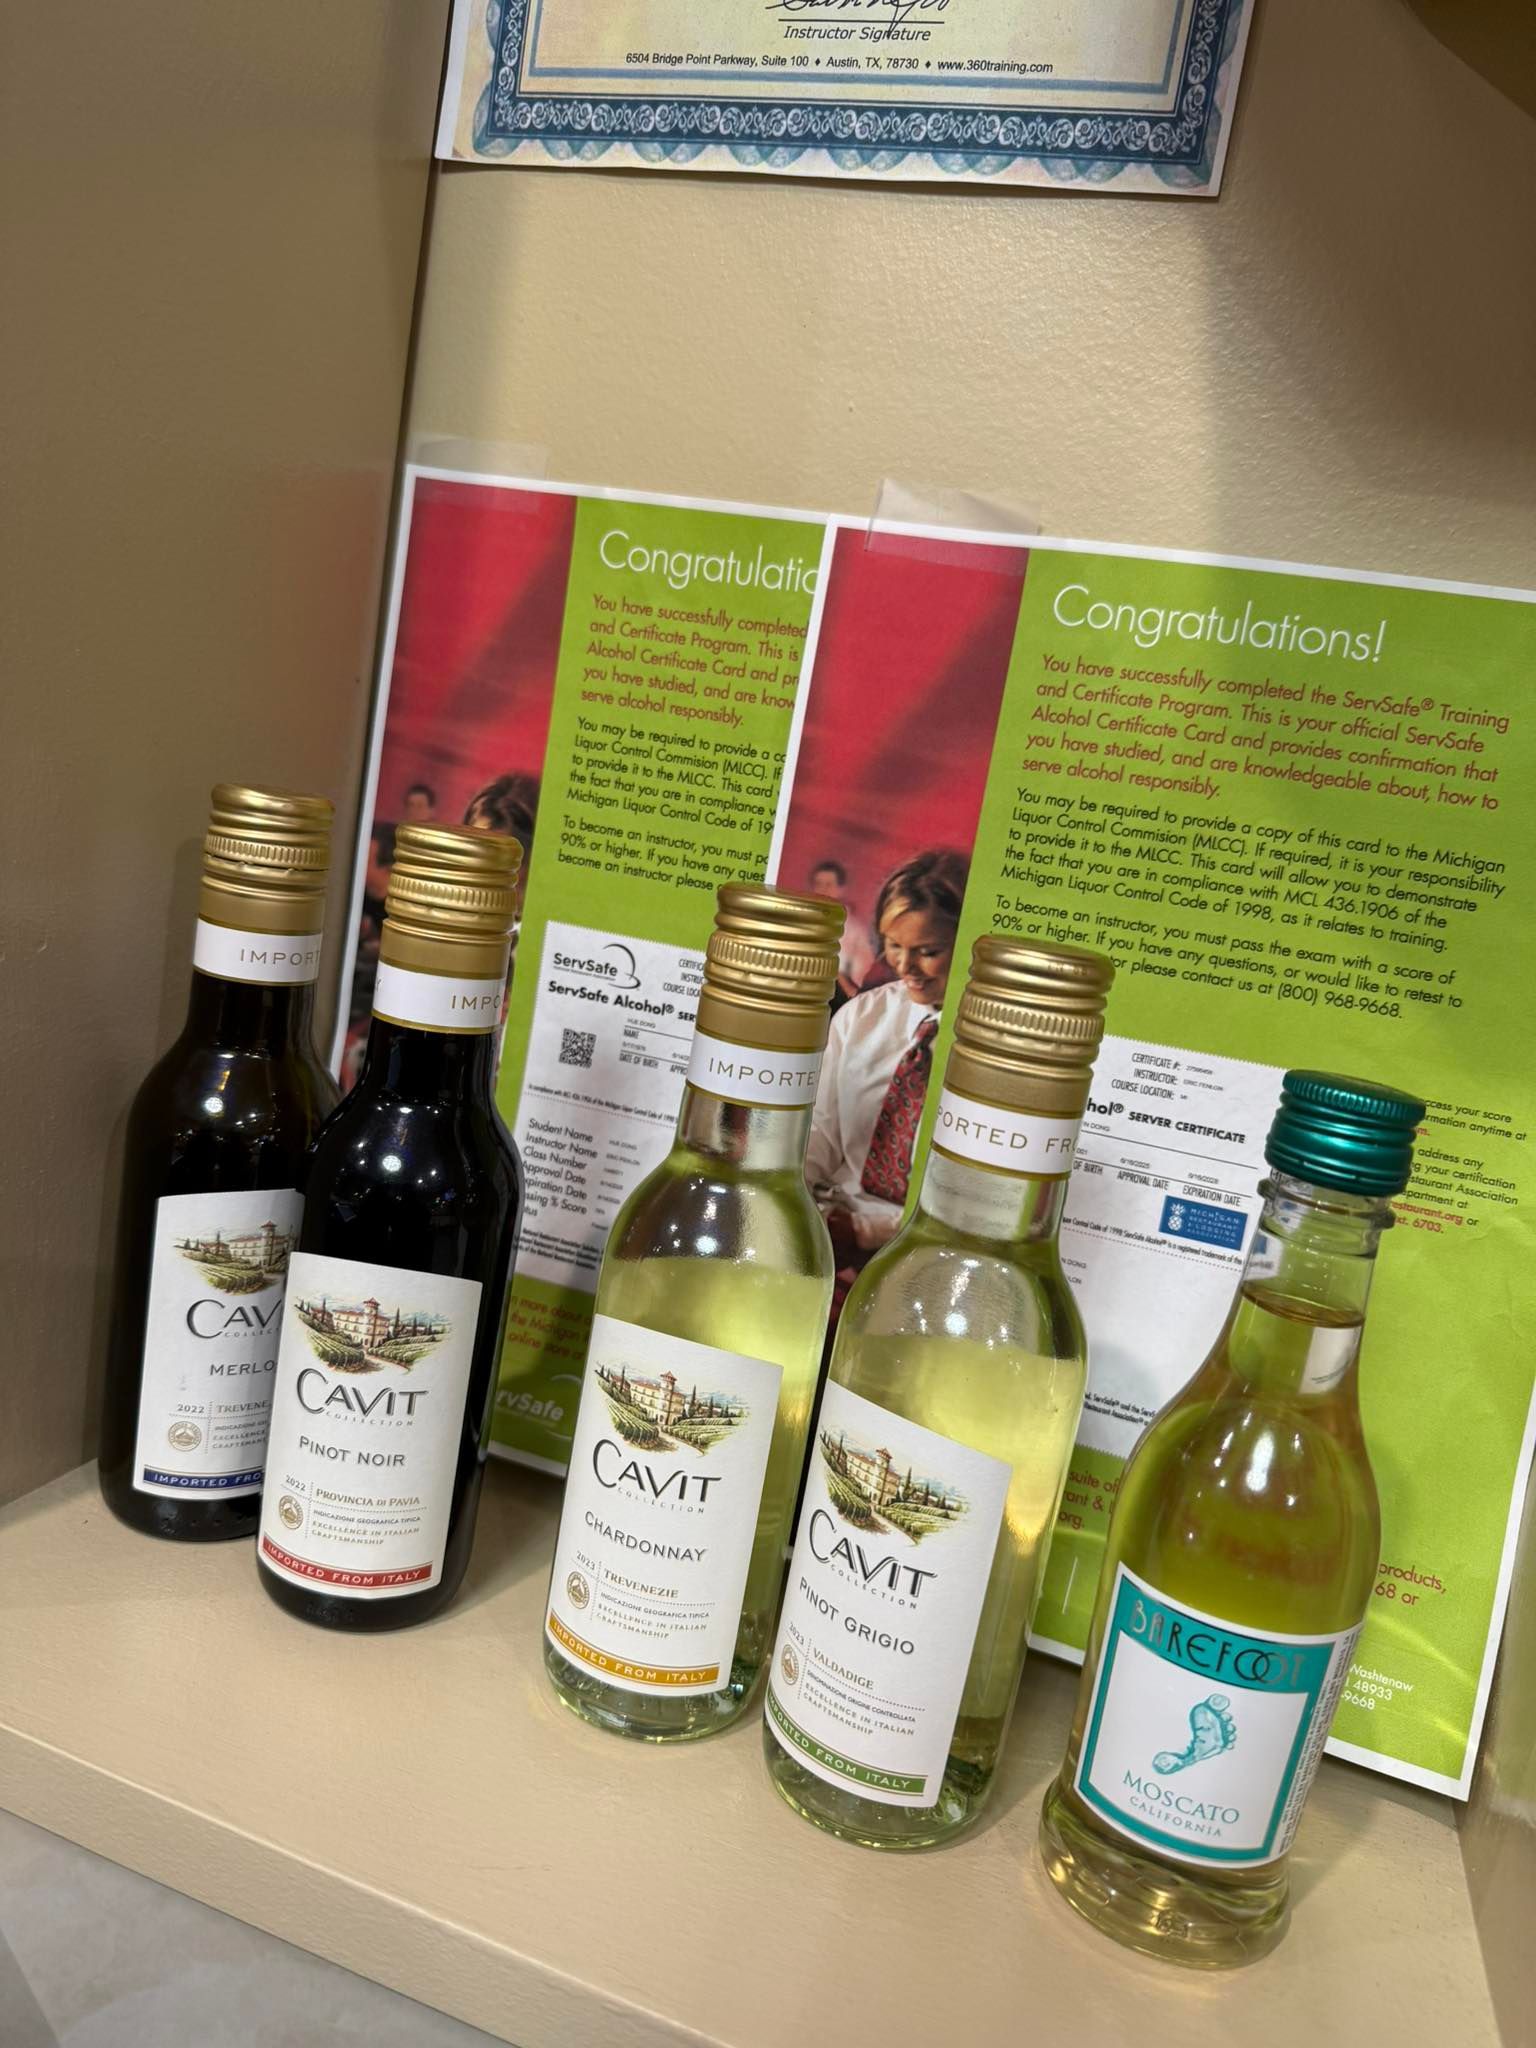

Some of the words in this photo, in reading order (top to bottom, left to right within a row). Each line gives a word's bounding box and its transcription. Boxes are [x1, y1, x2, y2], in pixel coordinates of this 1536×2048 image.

[783, 25, 857, 40] Instructor
[858, 23, 932, 43] Signature
[625, 52, 650, 64] 6504
[652, 52, 684, 67] Bridge
[685, 53, 711, 65] Point
[713, 53, 758, 68] Parkway,
[761, 54, 788, 67] Suite
[790, 55, 809, 67] 100
[825, 56, 861, 69] Austin,
[865, 56, 883, 70] TX,
[886, 57, 920, 70] 78730
[937, 59, 1054, 75] www.360training.com
[592, 593, 617, 612] You
[621, 597, 654, 617] have
[655, 607, 734, 631] successfully
[737, 619, 808, 639] completed
[1052, 586, 1386, 662] Congratulations!
[580, 689, 617, 705] serve
[617, 692, 666, 713] alcohol
[669, 704, 744, 729] responsibly.
[1036, 680, 1069, 699] and
[1071, 683, 1154, 709] Certificate
[1156, 693, 1233, 720] Program.
[1242, 704, 1273, 725] This
[1278, 714, 1291, 727] is
[1295, 716, 1338, 734] your
[1339, 719, 1400, 741] official
[1405, 726, 1485, 753] ServSafe
[1042, 653, 1071, 674] You
[1075, 656, 1115, 678] have
[1119, 667, 1213, 695] successfully
[1216, 680, 1306, 702] completed
[1310, 686, 1337, 706] the
[1440, 703, 1510, 734] Training
[1030, 704, 1093, 728] Alcohol
[1096, 712, 1179, 739] Certificate
[1183, 723, 1227, 745] Card
[1230, 733, 1266, 750] and
[1268, 740, 1343, 761] provides
[1347, 749, 1457, 777] confirmation
[1463, 761, 1499, 783] that
[1022, 759, 1063, 776] serve
[1066, 760, 1125, 784] alcohol
[1128, 773, 1221, 801] responsibly.
[1025, 734, 1056, 750] you
[1060, 732, 1099, 754] have
[1103, 741, 1165, 766] studied,
[1171, 751, 1206, 768] and
[1209, 758, 1239, 773] are
[1241, 757, 1372, 792] knowledgeable
[1375, 778, 1430, 804] about,
[1435, 785, 1478, 807] how
[1481, 793, 1499, 811] to
[1000, 863, 1064, 889] Michigan
[1067, 874, 1110, 895] Liquor
[1113, 882, 1165, 903] Control
[1168, 890, 1209, 910] Code
[1212, 898, 1230, 913] of
[1235, 901, 1275, 924] 1998,
[1280, 913, 1299, 925] as
[1303, 914, 1313, 927] it
[1315, 915, 1365, 937] relates
[1369, 925, 1385, 939] to
[1388, 928, 1448, 954] training.
[1129, 957, 1179, 978] please
[1181, 970, 1235, 988] contact
[1237, 980, 1253, 993] us
[1257, 983, 1274, 997] at
[1275, 982, 1319, 1007] (800)
[1324, 990, 1403, 1019] 968-9668.
[1046, 1136, 1079, 1154] FR
[177, 1404, 205, 1413] 2022
[296, 1368, 431, 1418] CAVIT
[299, 1435, 351, 1463] PINOT
[357, 1449, 406, 1467] NOIR
[592, 1438, 722, 1503] CAVIT
[153, 1474, 228, 1487] IMPORTED
[285, 1475, 306, 1492] 2022
[316, 1489, 374, 1506] PROVINCIA
[377, 1499, 387, 1507] DI
[390, 1496, 420, 1506] PAVIA
[584, 1510, 708, 1563] CHARDONNAY
[809, 1508, 937, 1599] CAVIT
[267, 1544, 326, 1579] IMPORTED
[332, 1572, 373, 1585] FROM
[381, 1570, 422, 1584] ITALY
[575, 1551, 597, 1572] 2023
[603, 1568, 679, 1599] TREVENEZIE
[830, 1562, 918, 1609] COLLECTION
[799, 1577, 839, 1622] PINOT
[844, 1616, 915, 1655] GRIGIO
[551, 1623, 608, 1667] IMPORTED
[615, 1663, 657, 1681] FROM
[665, 1669, 707, 1683] ITALY
[789, 1621, 805, 1646] 2023
[813, 1647, 874, 1691] VALDADIGE
[1130, 1599, 1306, 1688] BAREFOOT
[768, 1692, 810, 1751] IMPORTED
[816, 1748, 857, 1775] FROM
[865, 1769, 910, 1790] ITALY
[1123, 1769, 1240, 1825] MOSCATO
[1130, 1796, 1222, 1837] CALIFORNIA
